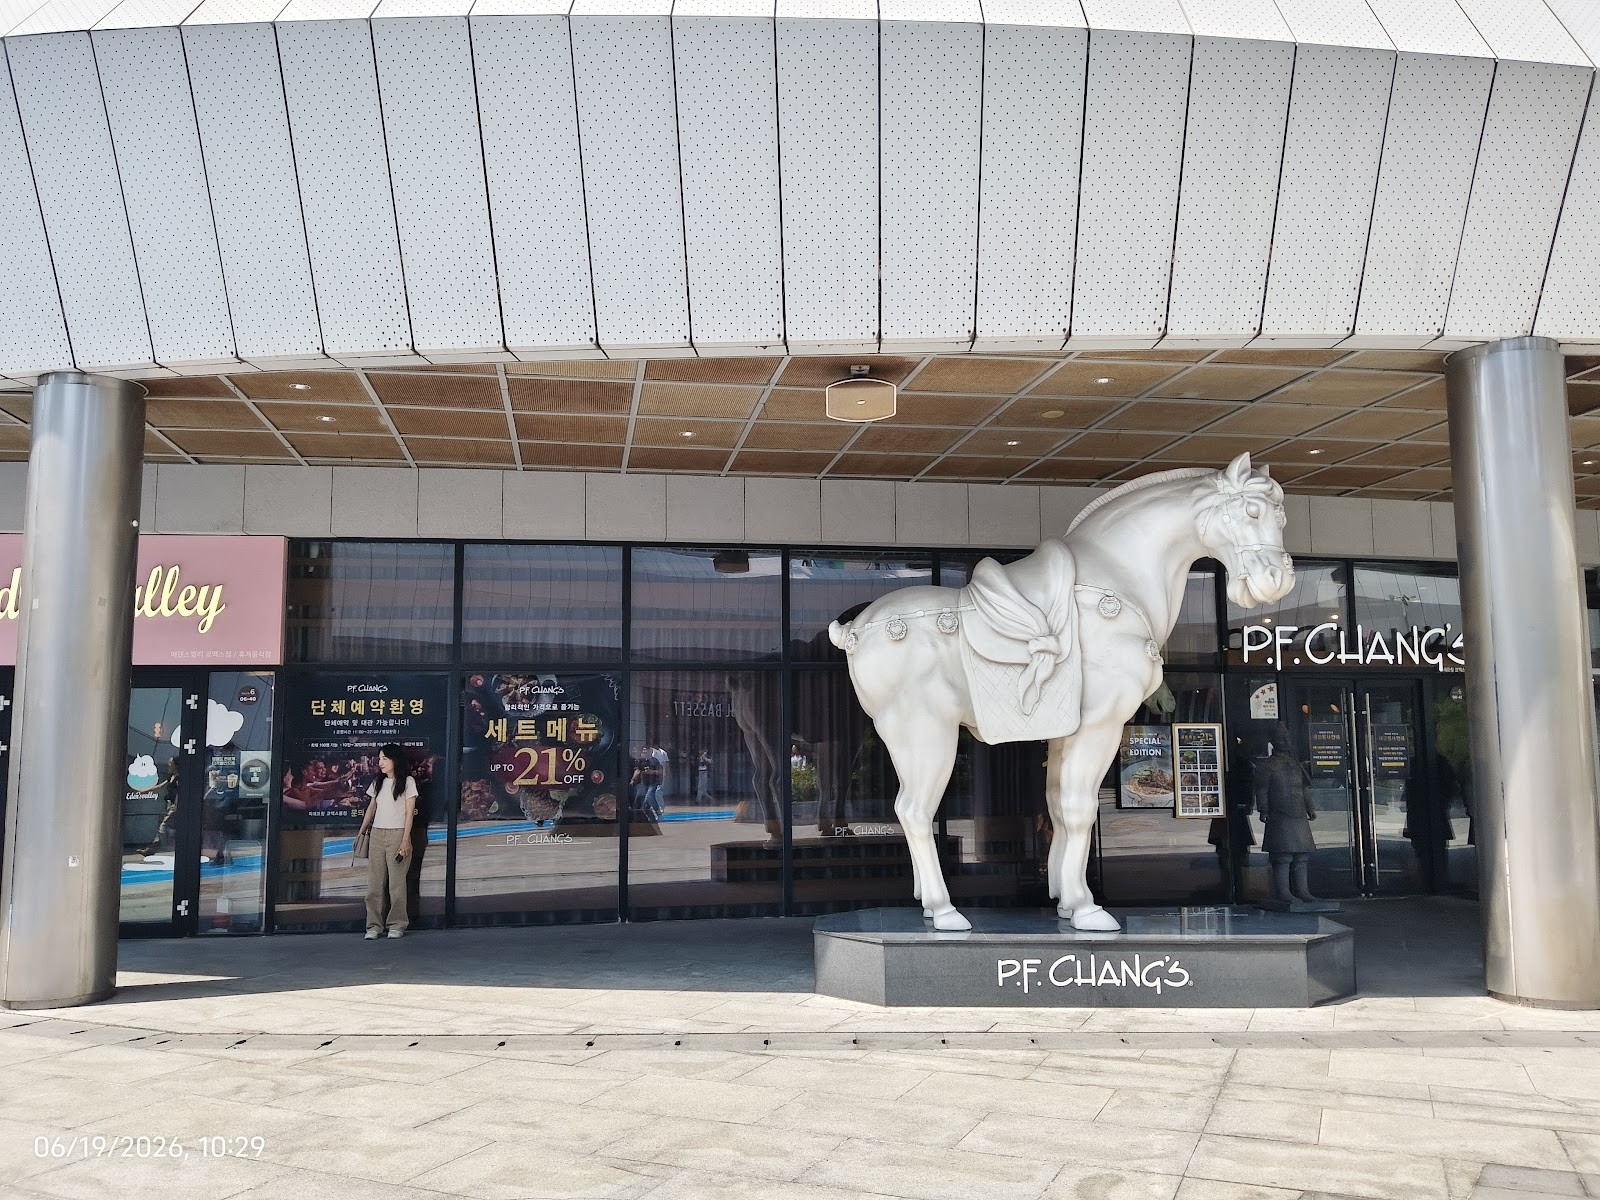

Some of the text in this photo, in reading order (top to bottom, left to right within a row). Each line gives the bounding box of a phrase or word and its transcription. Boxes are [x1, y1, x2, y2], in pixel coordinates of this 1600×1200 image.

[310, 698, 424, 716] 단체예약환영
[533, 703, 559, 711] 가격으로
[484, 717, 599, 744] 세트메뉴
[1129, 737, 1161, 745] SPECIAL
[1129, 748, 1162, 756] EDITION
[490, 764, 501, 773] UP
[503, 764, 515, 773] TO
[563, 774, 585, 784] OFF
[997, 953, 1190, 995] P.F. CHANG'S
